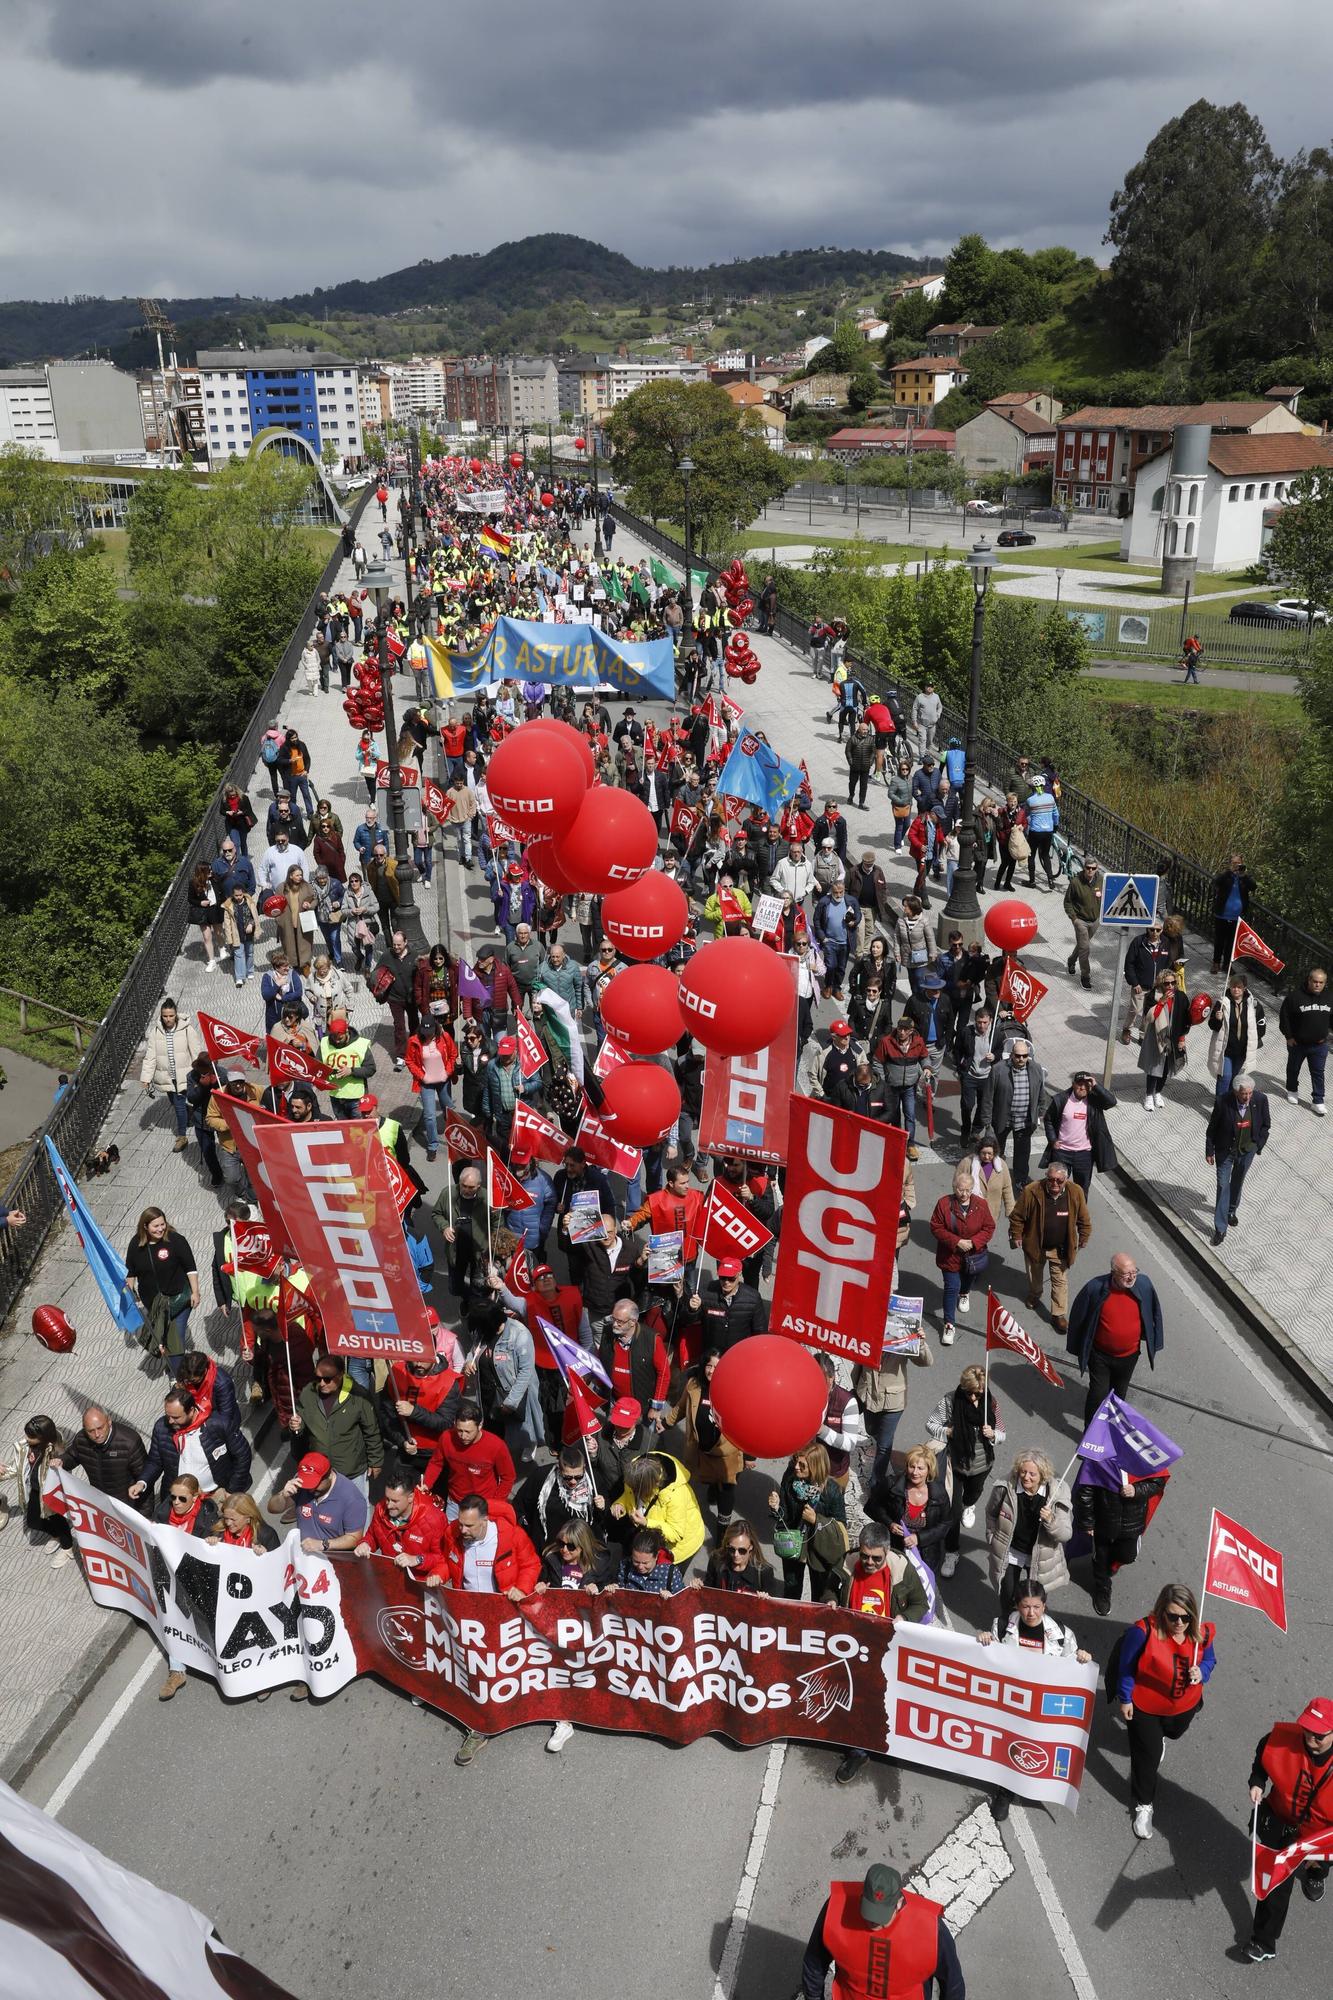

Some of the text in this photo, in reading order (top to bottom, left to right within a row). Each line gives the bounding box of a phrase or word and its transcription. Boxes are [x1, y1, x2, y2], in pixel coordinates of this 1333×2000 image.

[608, 920, 664, 938] CCOO
[326, 1053, 361, 1068] UGT
[797, 1111, 886, 1325] UGT
[337, 1333, 424, 1354] ASTURIES
[781, 1313, 871, 1358] ASTURIAS
[1214, 1526, 1279, 1588] CCOO
[1212, 1579, 1250, 1598] ASTURIAS
[424, 1590, 488, 1649] POR
[556, 1613, 684, 1653] PLENO
[693, 1613, 870, 1663] EMPLEO:
[425, 1618, 756, 1687] MENOS JORNADA,
[425, 1647, 792, 1715] MEJORES SALARIOS
[907, 1655, 1033, 1713] CCOO
[909, 1706, 1003, 1757] UGT
